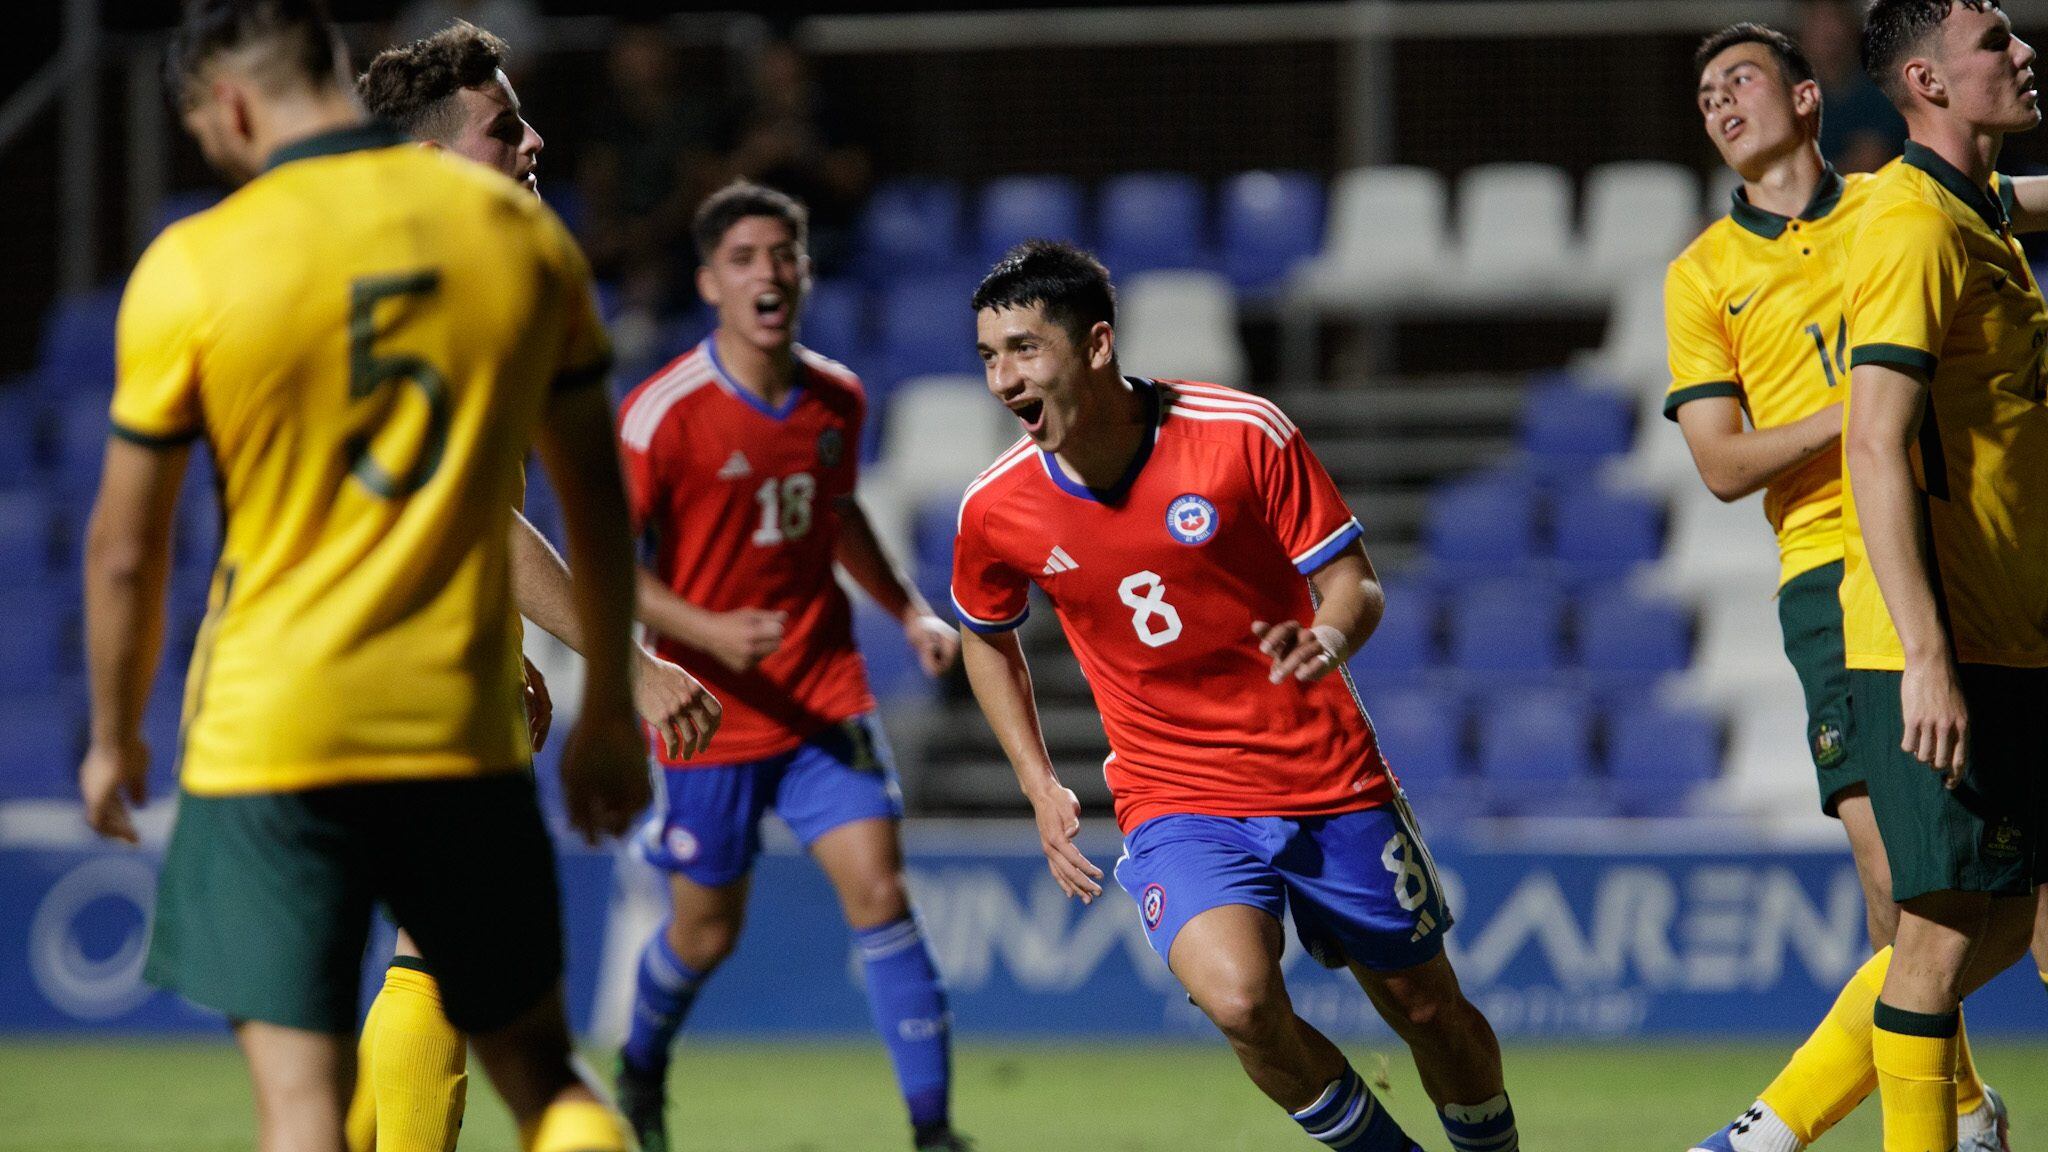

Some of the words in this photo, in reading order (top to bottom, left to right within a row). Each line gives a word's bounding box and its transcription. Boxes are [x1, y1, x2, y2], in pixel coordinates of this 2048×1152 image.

[348, 267, 449, 500] 5
[751, 471, 817, 548] 18
[1117, 569, 1183, 649] 8
[1380, 831, 1428, 912] 8
[1460, 864, 1872, 992] AREN
